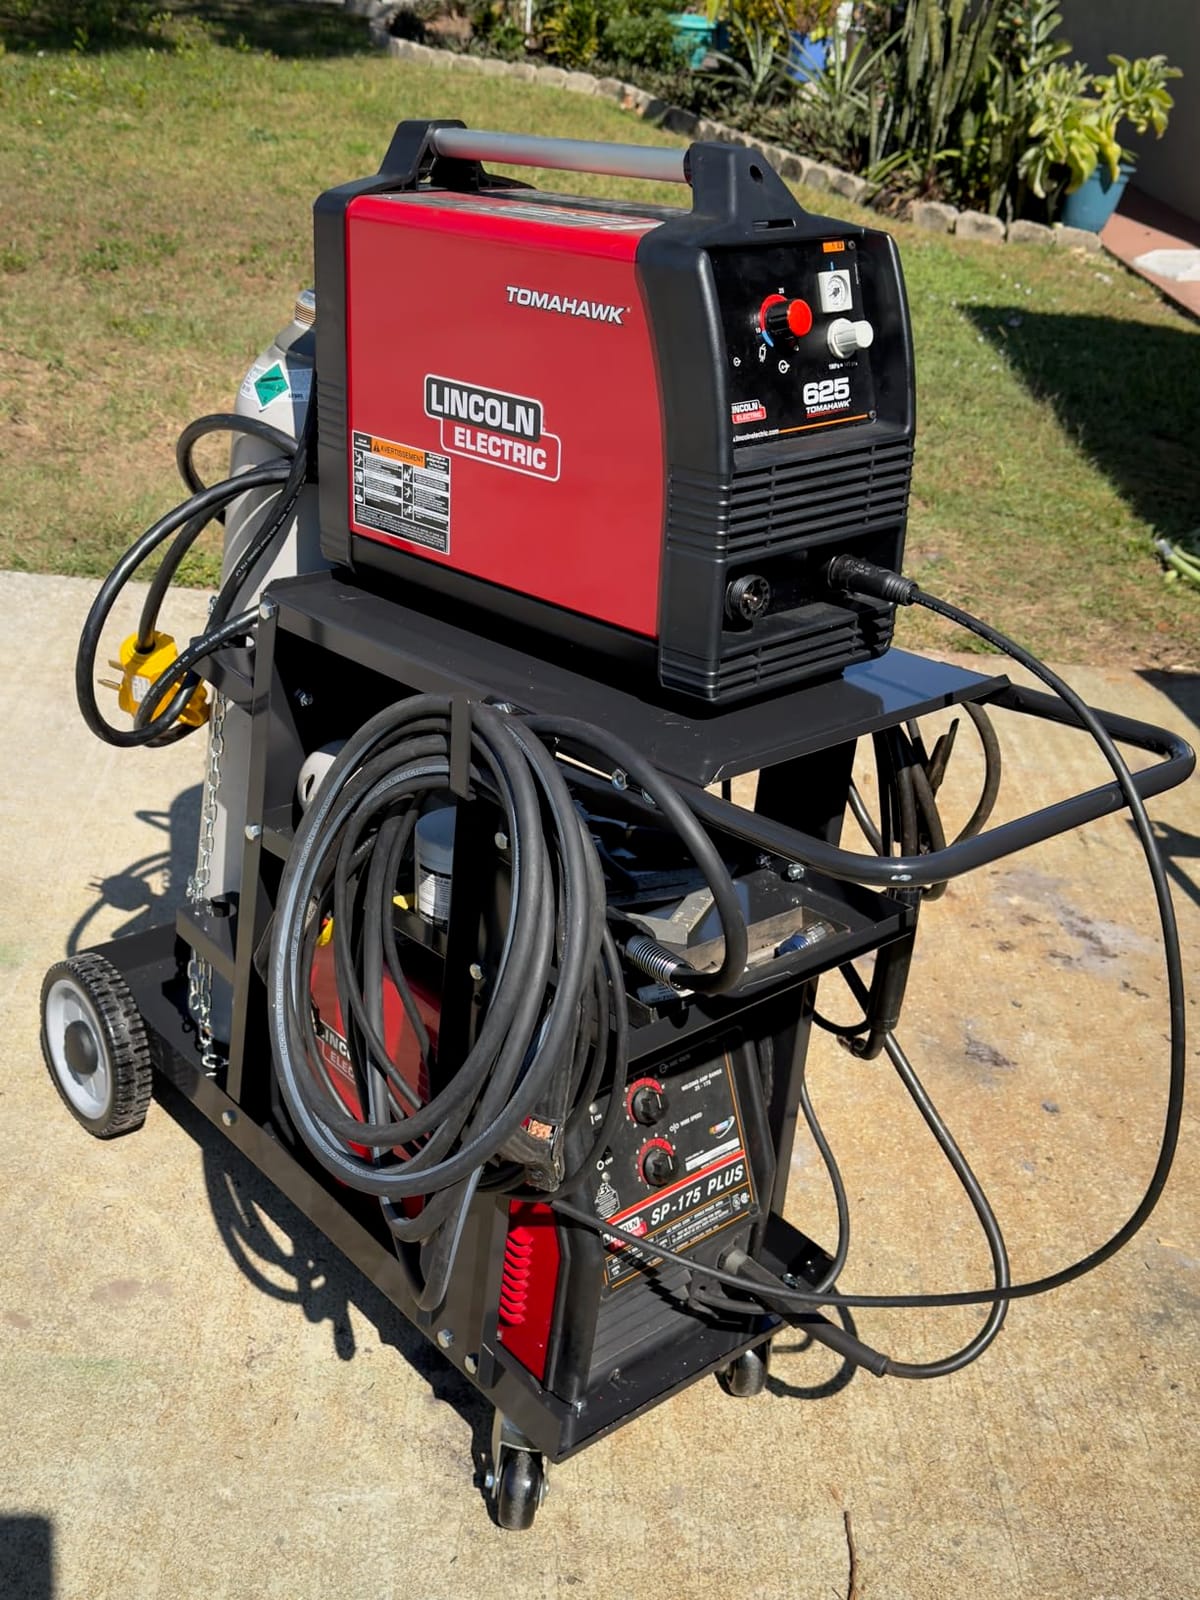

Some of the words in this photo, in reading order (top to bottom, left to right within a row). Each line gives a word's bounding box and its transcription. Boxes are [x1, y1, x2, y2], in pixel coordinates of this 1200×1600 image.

[506, 286, 624, 325] TOMAHAWK
[803, 377, 850, 405] 625
[805, 400, 850, 414] TOMAHAWK
[430, 382, 535, 436] LINCOLN
[731, 402, 758, 414] INCOLN
[380, 446, 424, 461] AVERTISSEMENT
[454, 426, 547, 471] ELECTRIC
[651, 1186, 701, 1226] SP-175
[707, 1164, 744, 1196] PLUS
